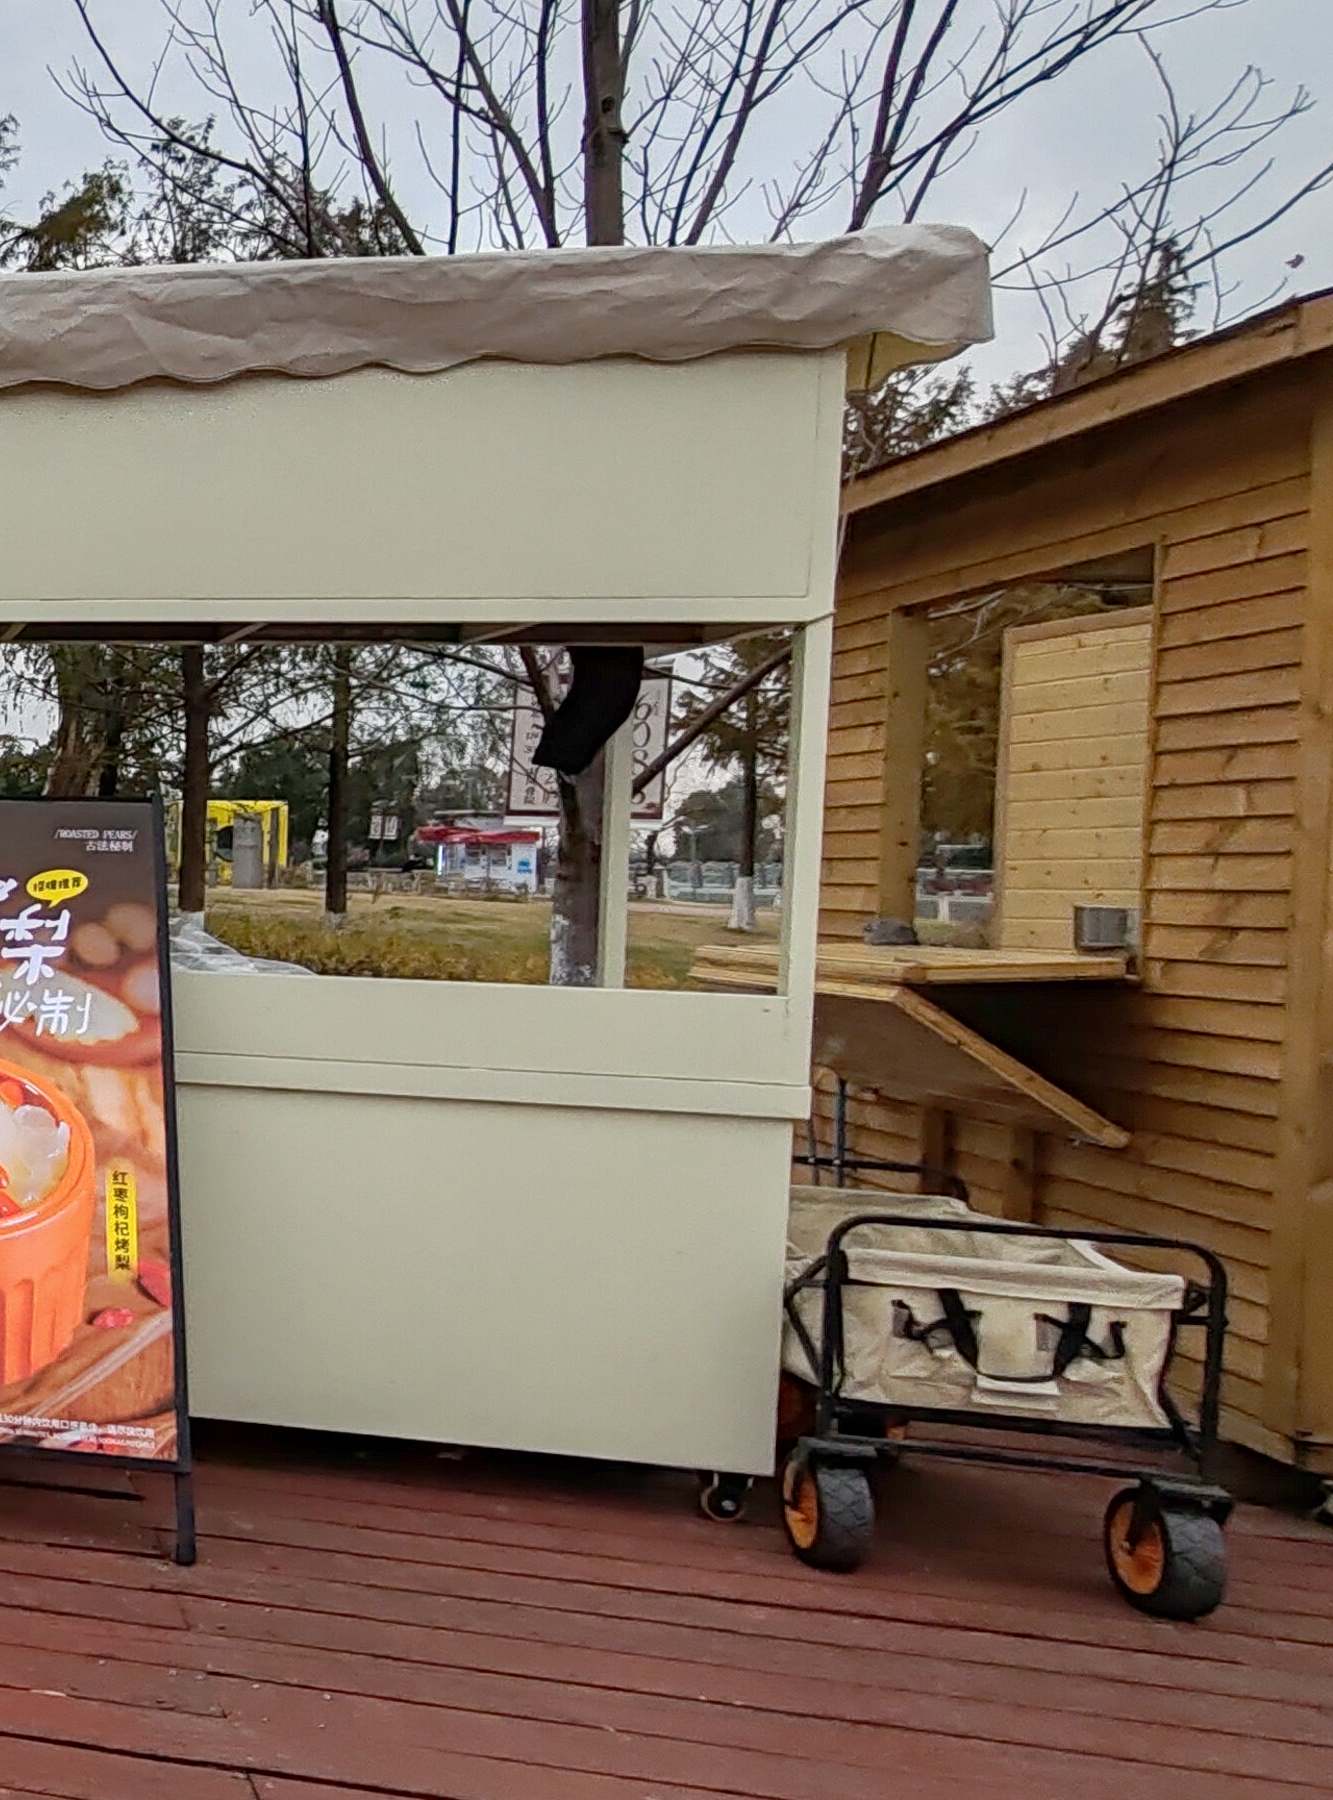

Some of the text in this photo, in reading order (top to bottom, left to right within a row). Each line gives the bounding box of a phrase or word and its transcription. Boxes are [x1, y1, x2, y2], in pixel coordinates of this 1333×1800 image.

[86, 840, 133, 853] 古法秘制
[111, 1169, 132, 1271] 红枣枸杞烤梨
